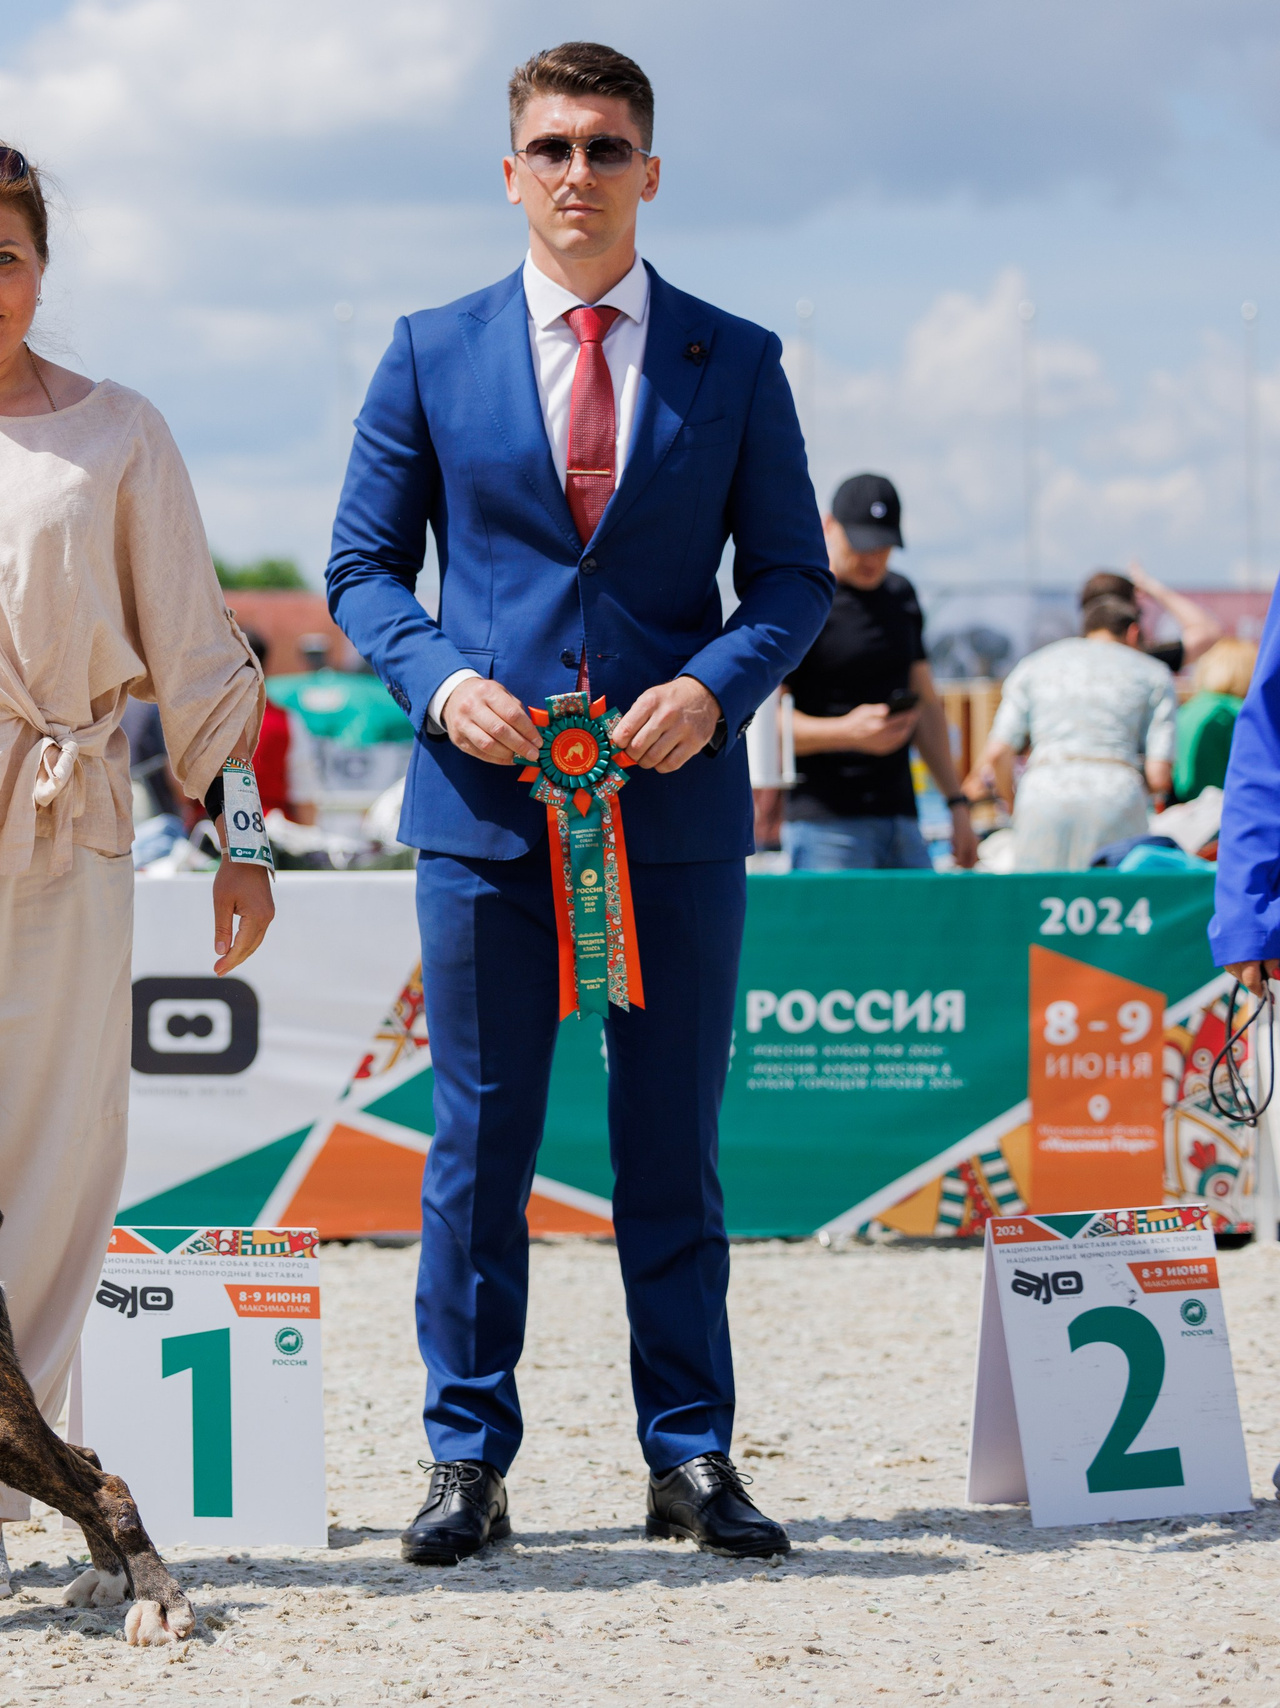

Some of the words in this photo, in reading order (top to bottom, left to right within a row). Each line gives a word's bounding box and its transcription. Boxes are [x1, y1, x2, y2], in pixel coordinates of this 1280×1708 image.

[233, 810, 266, 832] 08
[576, 886, 603, 894] РОССИЯ
[1039, 896, 1153, 936] 2024
[746, 988, 966, 1034] РОССИЯ
[1045, 1052, 1152, 1079] ИЮНЯ
[995, 1225, 1024, 1237] 2024
[998, 1244, 1070, 1254] НАЦИОНАЛЬНЫЕ
[1072, 1240, 1118, 1249] ВЫСТАВКИ
[1120, 1239, 1147, 1247] СОБАК
[1173, 1234, 1202, 1242] ПОРОД
[1006, 1254, 1077, 1264] НАЦИОНАЛЬНЫЕ
[1079, 1248, 1151, 1259] МОНОПОРОДНЫЕ
[1153, 1245, 1198, 1254] ВЫСТАВКИ
[168, 1258, 216, 1266] ВЫСТАВКИ
[220, 1259, 250, 1267] СОБАК
[253, 1260, 276, 1268] ВСЕХ
[279, 1261, 310, 1269] ПОРОД
[174, 1269, 252, 1278] МОНОПОРОДНЫЕ
[255, 1271, 304, 1279] ВЫСТАВКИ
[1142, 1267, 1163, 1278] 8-9
[1166, 1264, 1209, 1276] ИЮНЯ
[1187, 1276, 1209, 1284] ПАРК
[239, 1291, 261, 1302] 8-9
[266, 1292, 311, 1303] ИЮНЯ
[239, 1304, 285, 1313] МАКСИМА
[286, 1304, 311, 1313] ПАРК
[1181, 1328, 1215, 1337] РОССИЯ
[272, 1359, 308, 1367] РОССИЯ
[1067, 1305, 1185, 1493] 2
[161, 1327, 233, 1518] 1
